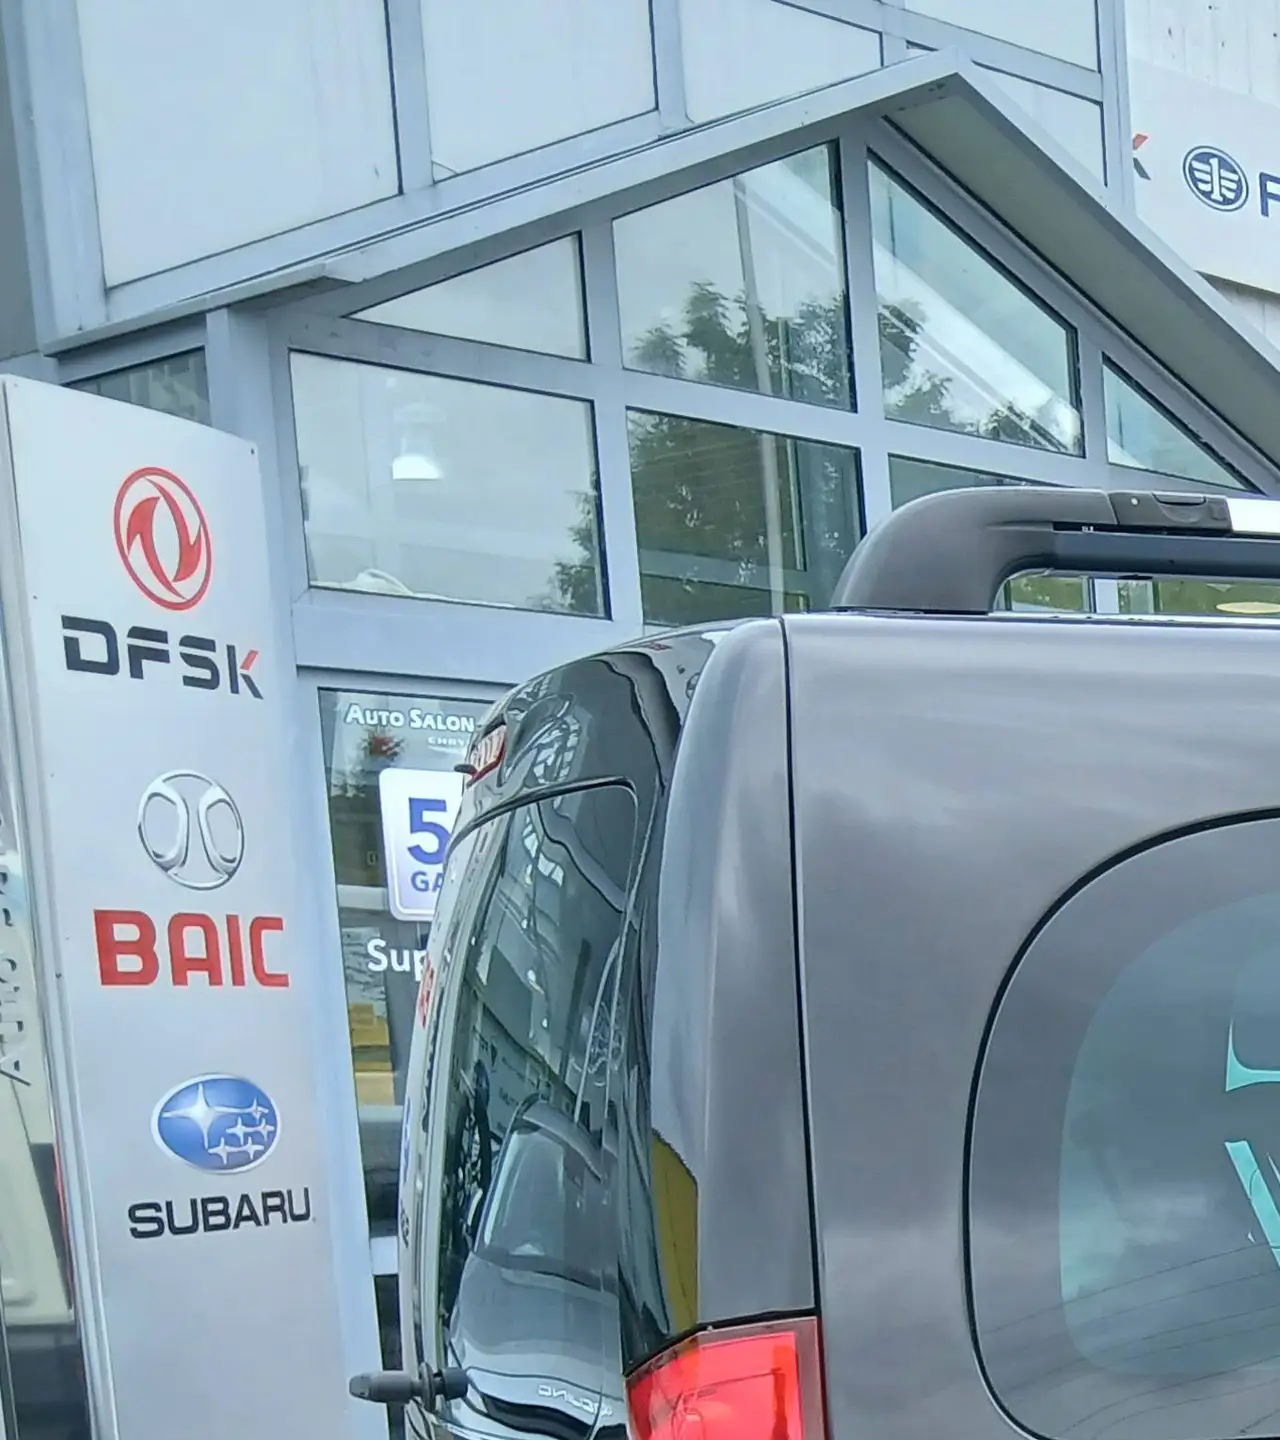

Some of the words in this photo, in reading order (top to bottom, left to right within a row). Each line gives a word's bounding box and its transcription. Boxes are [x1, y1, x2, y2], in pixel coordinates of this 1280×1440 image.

[61, 614, 264, 700] DFSK
[407, 796, 450, 866] 5
[94, 909, 290, 988] BAIC
[127, 1187, 312, 1239] SUBARU
